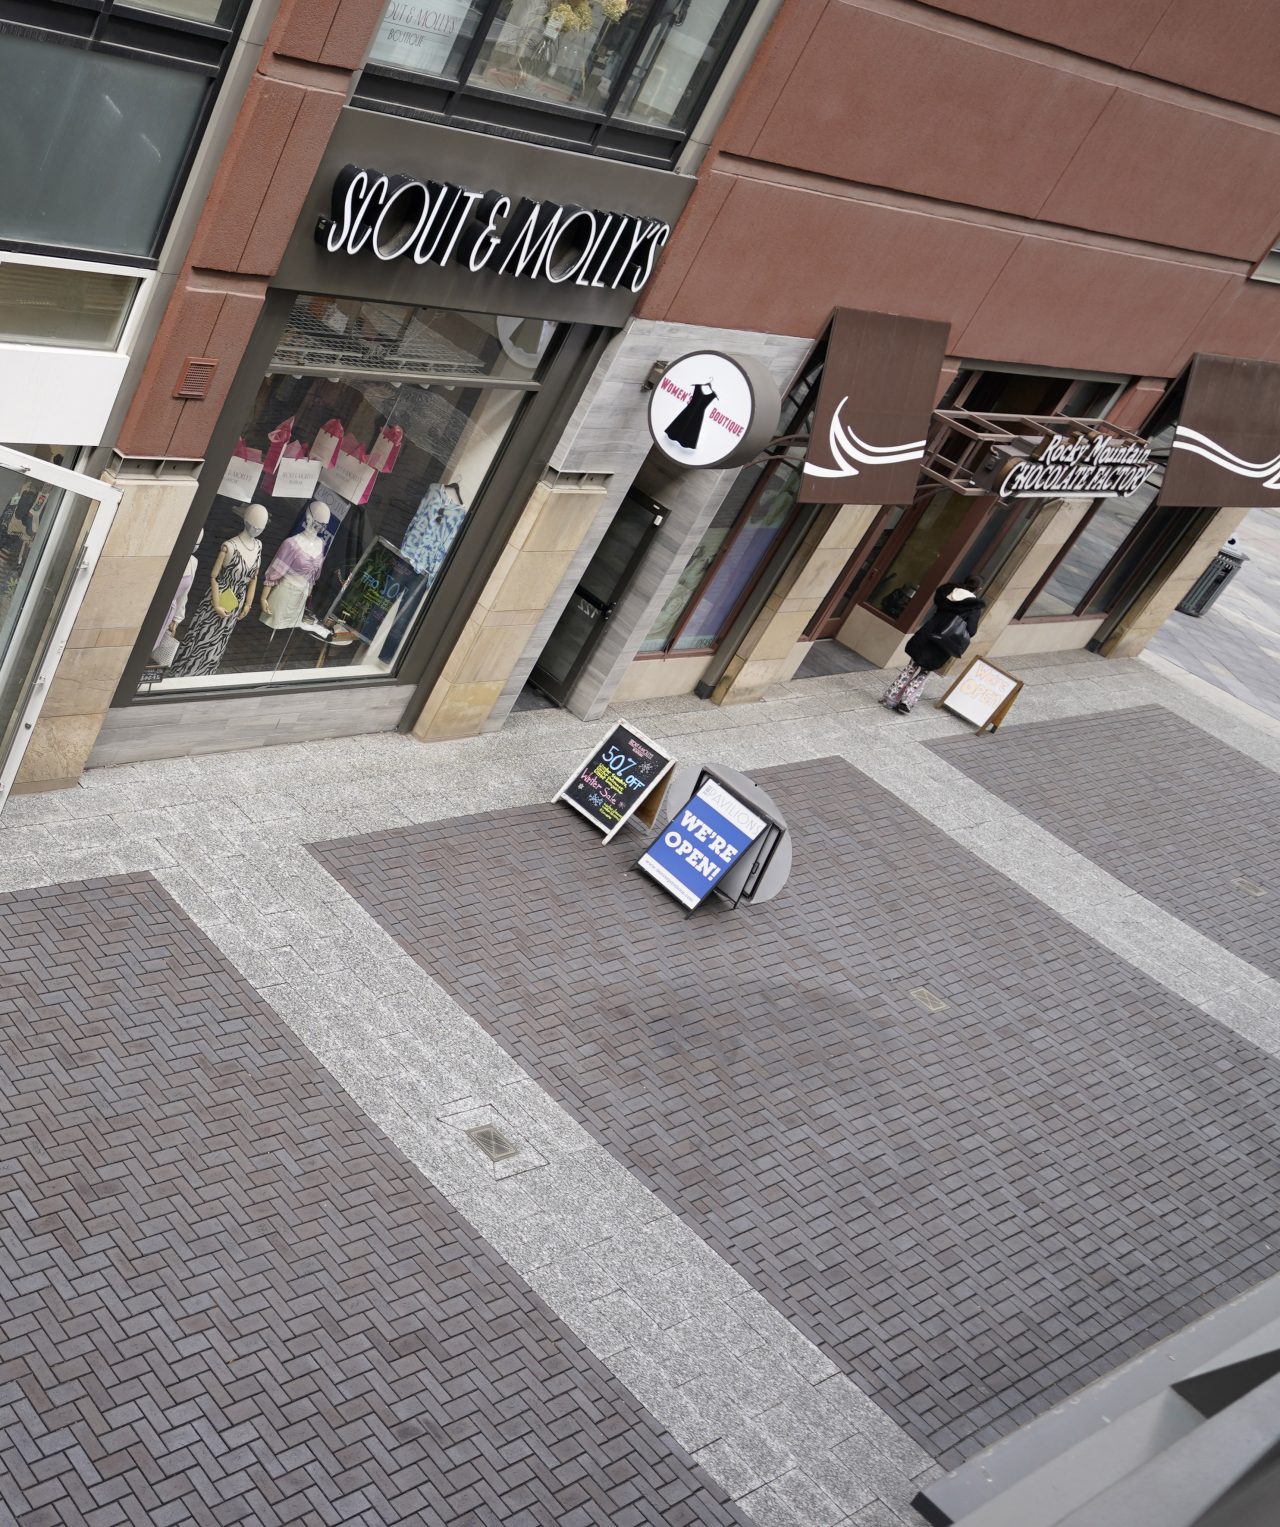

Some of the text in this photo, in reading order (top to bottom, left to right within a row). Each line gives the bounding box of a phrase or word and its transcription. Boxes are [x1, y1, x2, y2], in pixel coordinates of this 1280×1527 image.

[320, 167, 672, 294] SCOUT & MOLLY'S
[660, 377, 694, 405] WOMEN'S
[708, 407, 745, 438] BOUTIQUE
[1039, 434, 1152, 467] Rocky Mountain
[1000, 462, 1158, 498] CHOCOLATE FACTORY
[580, 767, 603, 791] Winter
[599, 786, 618, 805] Sale
[602, 745, 638, 777] 50%
[625, 775, 646, 791] OFF
[707, 784, 764, 836] PAVILIONS
[664, 831, 723, 882] OPEN!
[680, 810, 739, 864] WE'RE
